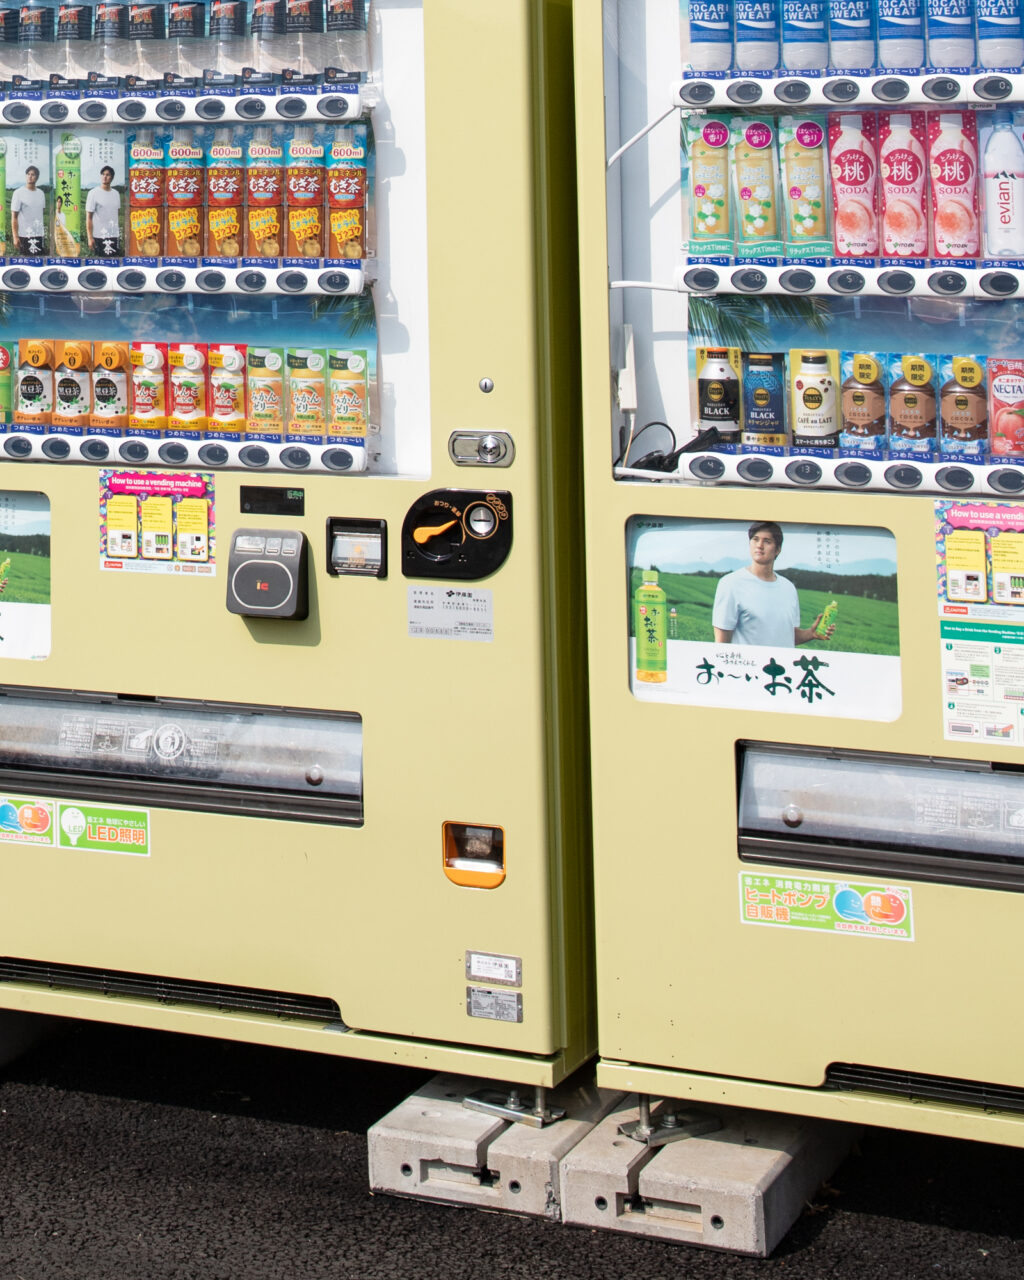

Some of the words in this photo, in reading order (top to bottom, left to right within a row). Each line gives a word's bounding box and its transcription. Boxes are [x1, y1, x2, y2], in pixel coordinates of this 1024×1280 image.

[689, 4, 728, 12] POCARI
[736, 3, 774, 11] POCARI
[784, 3, 823, 12] POCARI
[830, 2, 868, 10] POCARI
[878, 0, 920, 7] POCARI
[736, 11, 772, 20] SWEAT
[830, 10, 865, 18] SWEAT
[878, 8, 916, 16] SWEAT
[928, 7, 966, 15] SWEAT
[976, 7, 1016, 15] SWEAT
[689, 12, 726, 20] SWEAT
[784, 12, 819, 20] SWEAT
[132, 149, 163, 158] 600ml
[170, 148, 201, 158] 600ml
[212, 148, 240, 157] 600ml
[250, 148, 281, 157] 600ml
[292, 147, 322, 156] 600ml
[333, 148, 363, 157] 600ml
[841, 153, 864, 162] とろける
[889, 153, 913, 162] とろける
[940, 153, 964, 162] とろける
[842, 162, 865, 182] 桃
[890, 162, 914, 182] 桃
[941, 162, 965, 182] 桃
[131, 178, 160, 192] むぎ茶
[168, 177, 200, 192] むぎ茶
[209, 177, 239, 192] むぎ茶
[249, 177, 280, 192] むぎ茶
[289, 176, 320, 192] むぎ茶
[330, 178, 361, 194] むぎ茶
[840, 187, 869, 195] SODA
[887, 187, 917, 195] SODA
[938, 187, 969, 195] SODA
[996, 181, 1012, 225] evian
[251, 392, 278, 403] みかん
[293, 392, 320, 403] みかん
[334, 394, 360, 405] みかん
[253, 403, 275, 412] ゼリー
[296, 403, 317, 412] ゼリー
[336, 404, 358, 414] ゼリー
[704, 407, 730, 415] BLACK
[150, 479, 174, 488] vending
[175, 480, 202, 488] machine
[951, 509, 969, 518] How
[970, 510, 979, 518] to
[696, 654, 835, 704] お～いお茶
[87, 824, 145, 845] LED照明
[744, 877, 770, 887] 省エネ
[744, 887, 829, 909] ヒートポンプ
[746, 904, 790, 922] 自販機
